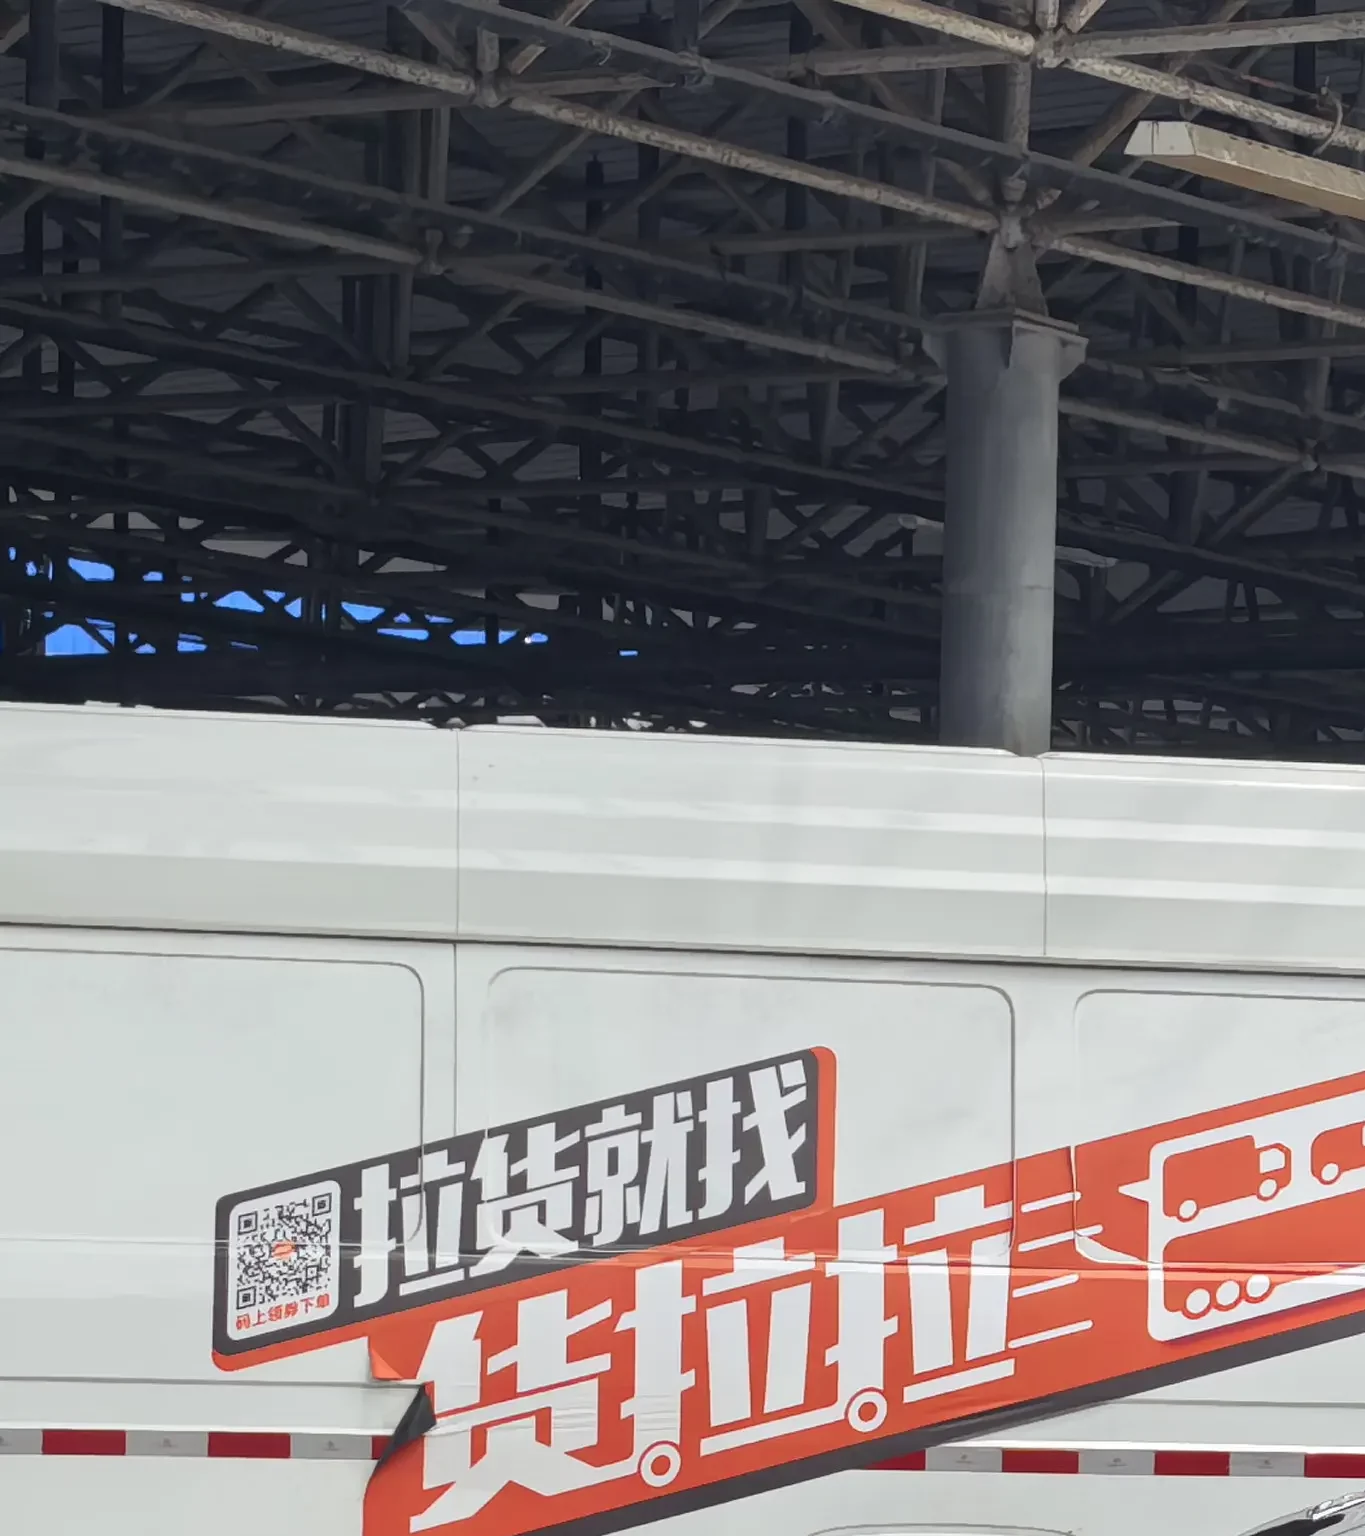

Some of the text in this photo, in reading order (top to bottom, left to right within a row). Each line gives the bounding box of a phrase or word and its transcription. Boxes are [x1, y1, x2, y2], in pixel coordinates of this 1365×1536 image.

[353, 1059, 807, 1308] 拉货就找
[235, 1293, 331, 1330] 码上领券下单
[410, 1185, 1016, 1534] 货拉拉
